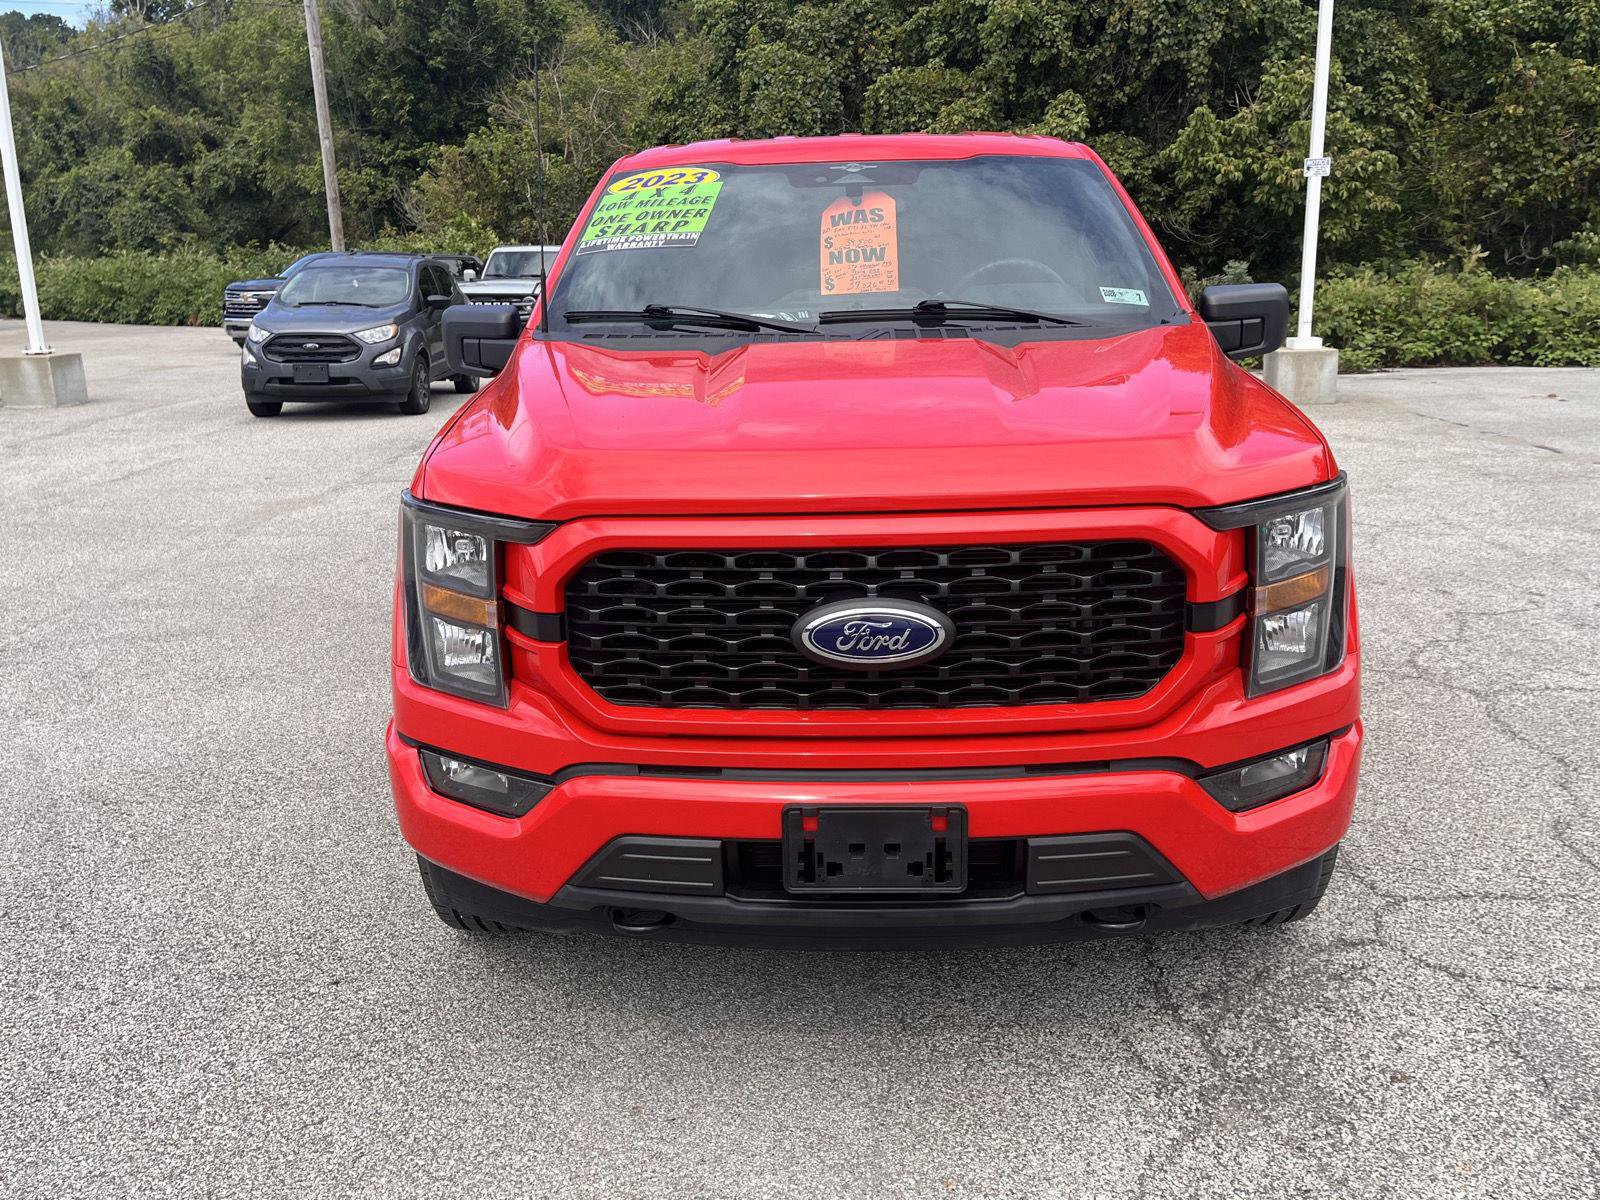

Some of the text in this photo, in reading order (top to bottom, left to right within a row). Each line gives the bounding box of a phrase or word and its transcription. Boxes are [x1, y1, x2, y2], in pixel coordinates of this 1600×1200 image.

[620, 172, 708, 190] 2023
[623, 190, 638, 200] 4
[679, 184, 696, 195] 4
[597, 195, 712, 213] LOW MILEAGE
[591, 208, 708, 227] ONE OWNER
[830, 208, 884, 228] WAS
[594, 220, 689, 237] SHARP
[580, 232, 698, 248] LIFETIME POWERTRAIN
[607, 240, 664, 250] WARRANTY
[824, 236, 834, 250] $
[829, 247, 886, 265] NOW
[825, 277, 835, 291] $
[836, 620, 911, 651] Ford
